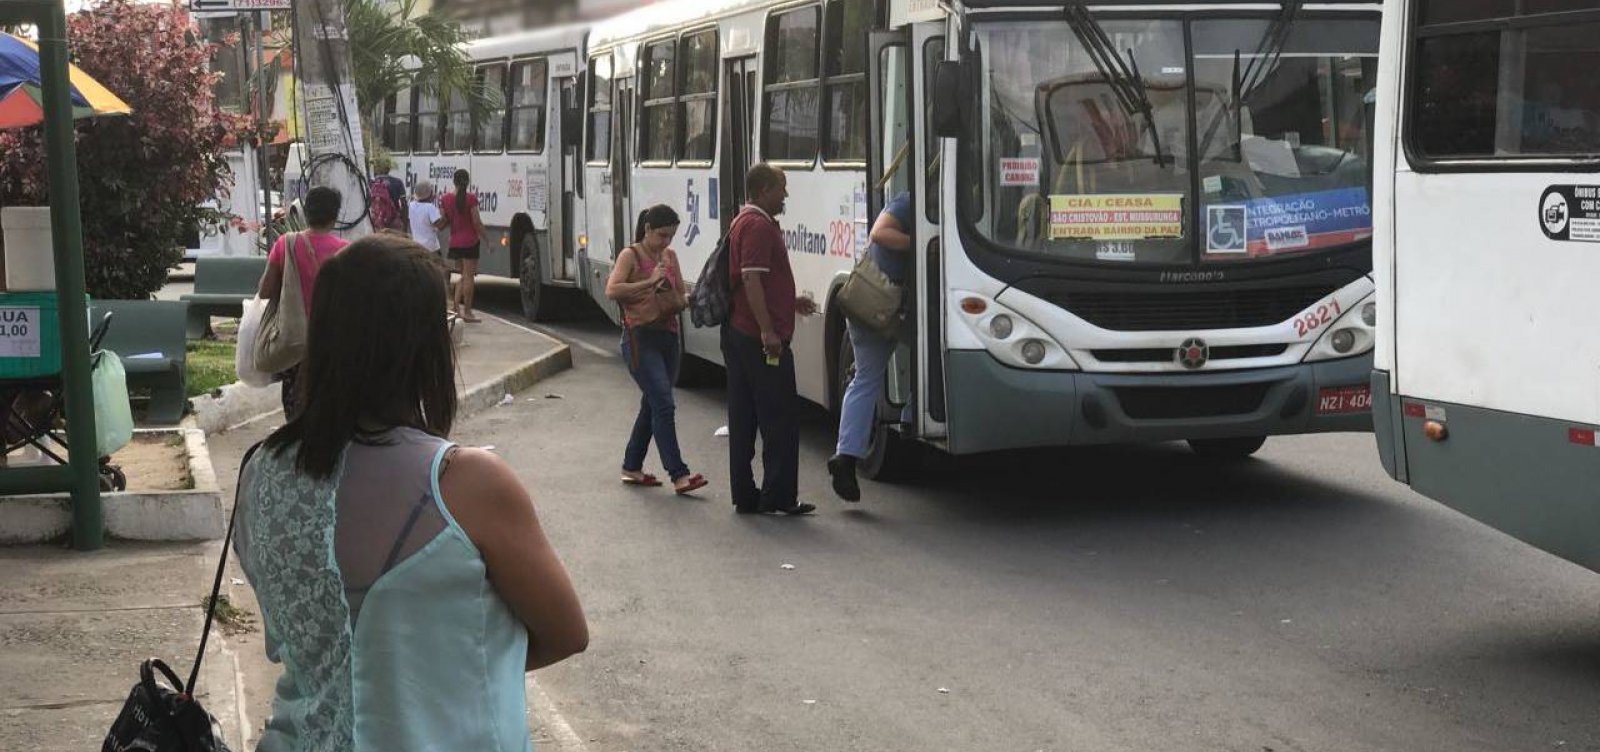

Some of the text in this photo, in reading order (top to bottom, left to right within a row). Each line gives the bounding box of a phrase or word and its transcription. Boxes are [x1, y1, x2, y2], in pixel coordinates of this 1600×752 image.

[429, 162, 457, 179] Express
[1068, 197, 1093, 208] CIA
[1105, 197, 1153, 207] CEASA
[1246, 199, 1315, 217] NTEGRAÇÃO
[1580, 200, 1595, 210] COM
[1052, 211, 1068, 222] SÃO
[1053, 225, 1179, 235] ENTRADA BAIRRO DA PAZ
[781, 222, 826, 256] politano
[0, 311, 28, 322] UA
[1294, 297, 1341, 338] 2821
[1320, 393, 1372, 410] NZI 404
